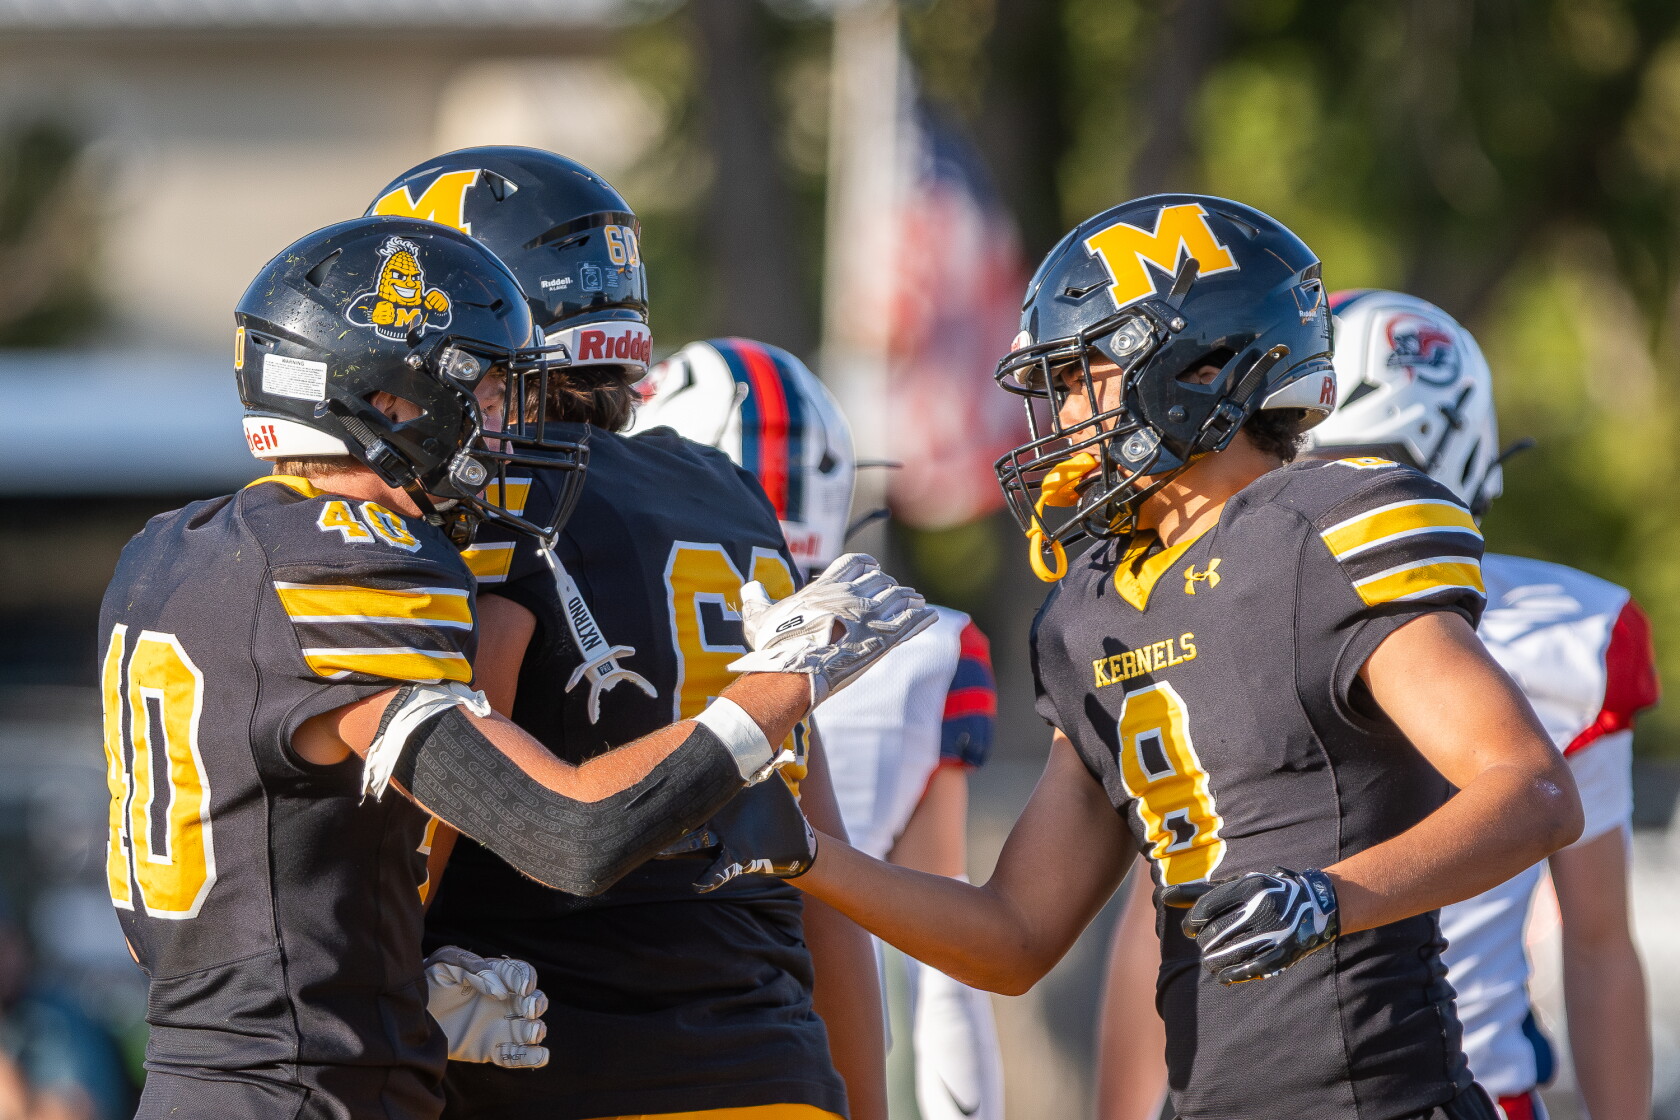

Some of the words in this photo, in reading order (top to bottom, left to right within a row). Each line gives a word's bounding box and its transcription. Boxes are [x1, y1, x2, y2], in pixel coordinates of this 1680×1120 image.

[372, 169, 481, 236] M
[604, 224, 640, 268] 60
[1085, 203, 1238, 309] M
[235, 326, 245, 369] 0
[281, 358, 305, 367] WARNING
[317, 500, 422, 553] 40
[568, 596, 602, 652] NXTRND
[599, 662, 612, 674] PRO
[1093, 632, 1198, 688] KERNELS
[1117, 680, 1228, 887] 8
